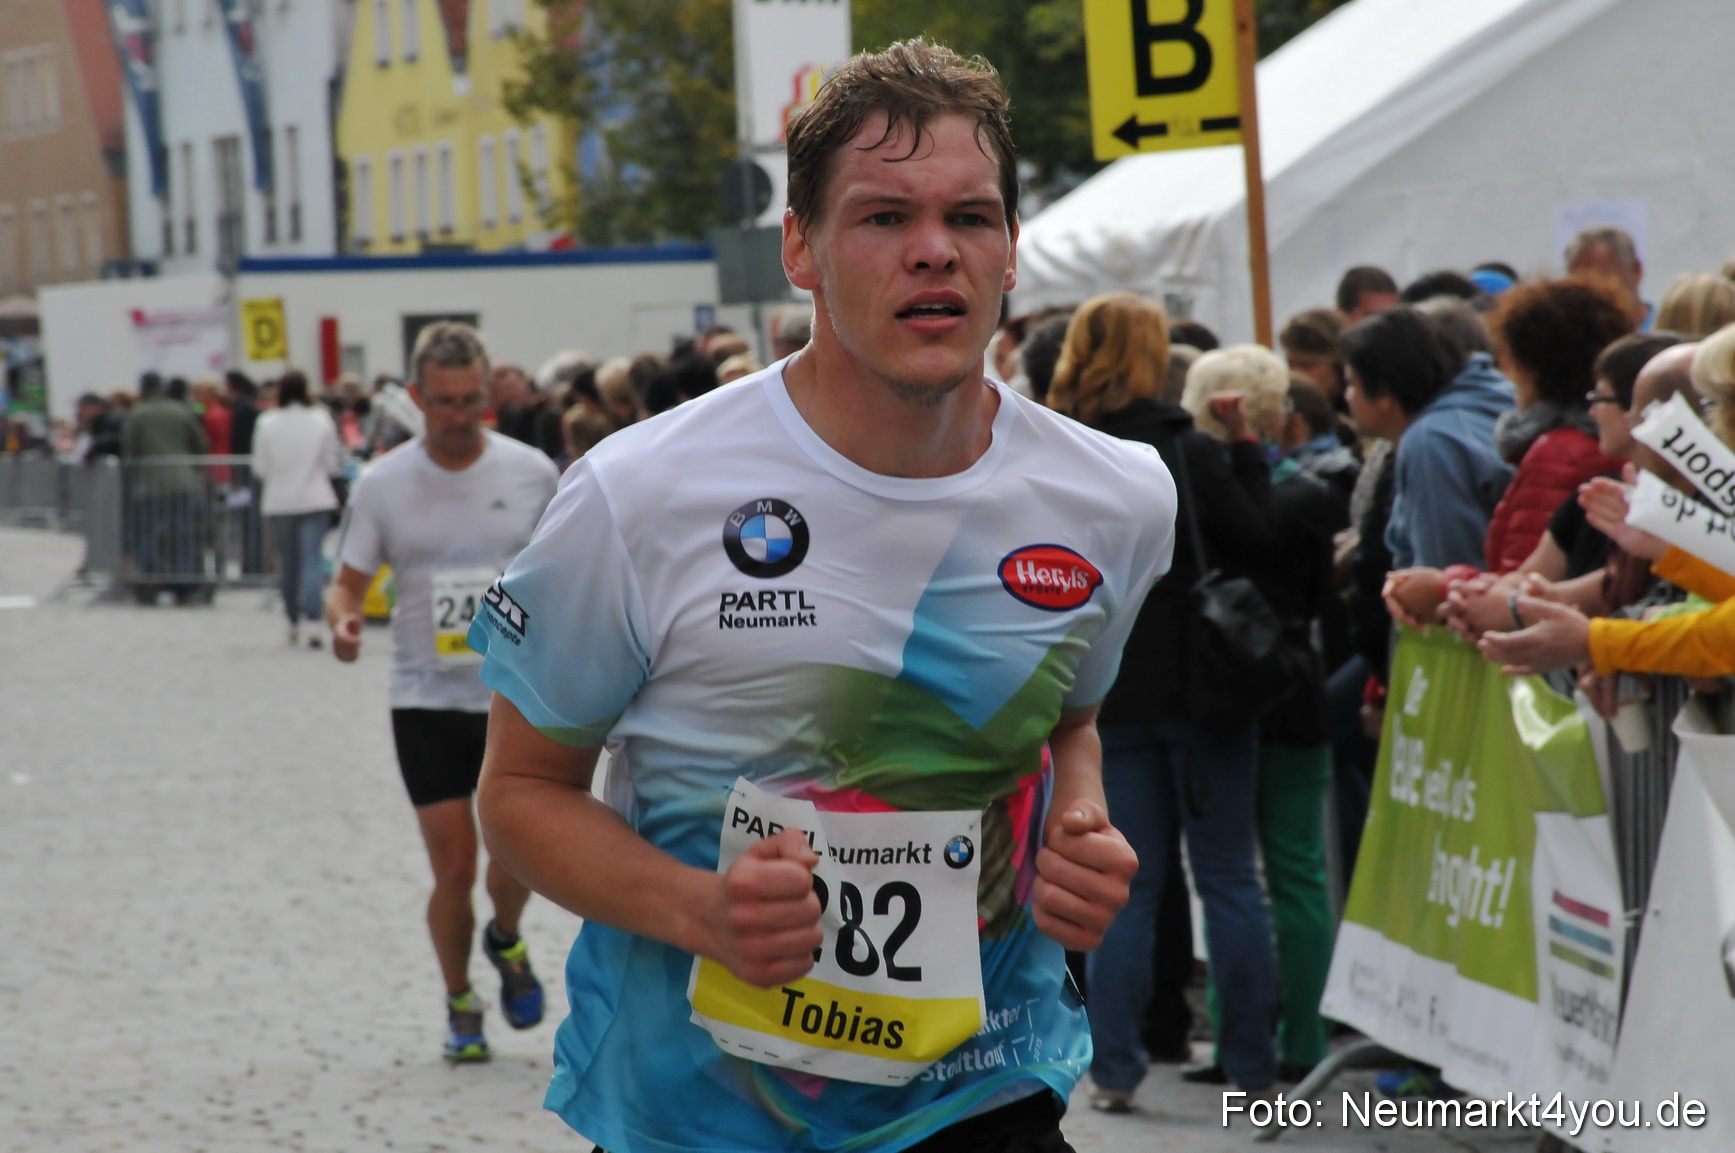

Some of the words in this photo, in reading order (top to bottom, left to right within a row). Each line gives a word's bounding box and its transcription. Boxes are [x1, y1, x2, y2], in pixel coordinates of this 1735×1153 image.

[1130, 0, 1213, 98] B
[254, 316, 278, 349] D
[1015, 559, 1090, 593] Hervis
[720, 590, 816, 612] PARTL
[718, 611, 818, 630] Neumarkt
[827, 841, 932, 866] eumarkt
[782, 986, 905, 1049] Tobias
